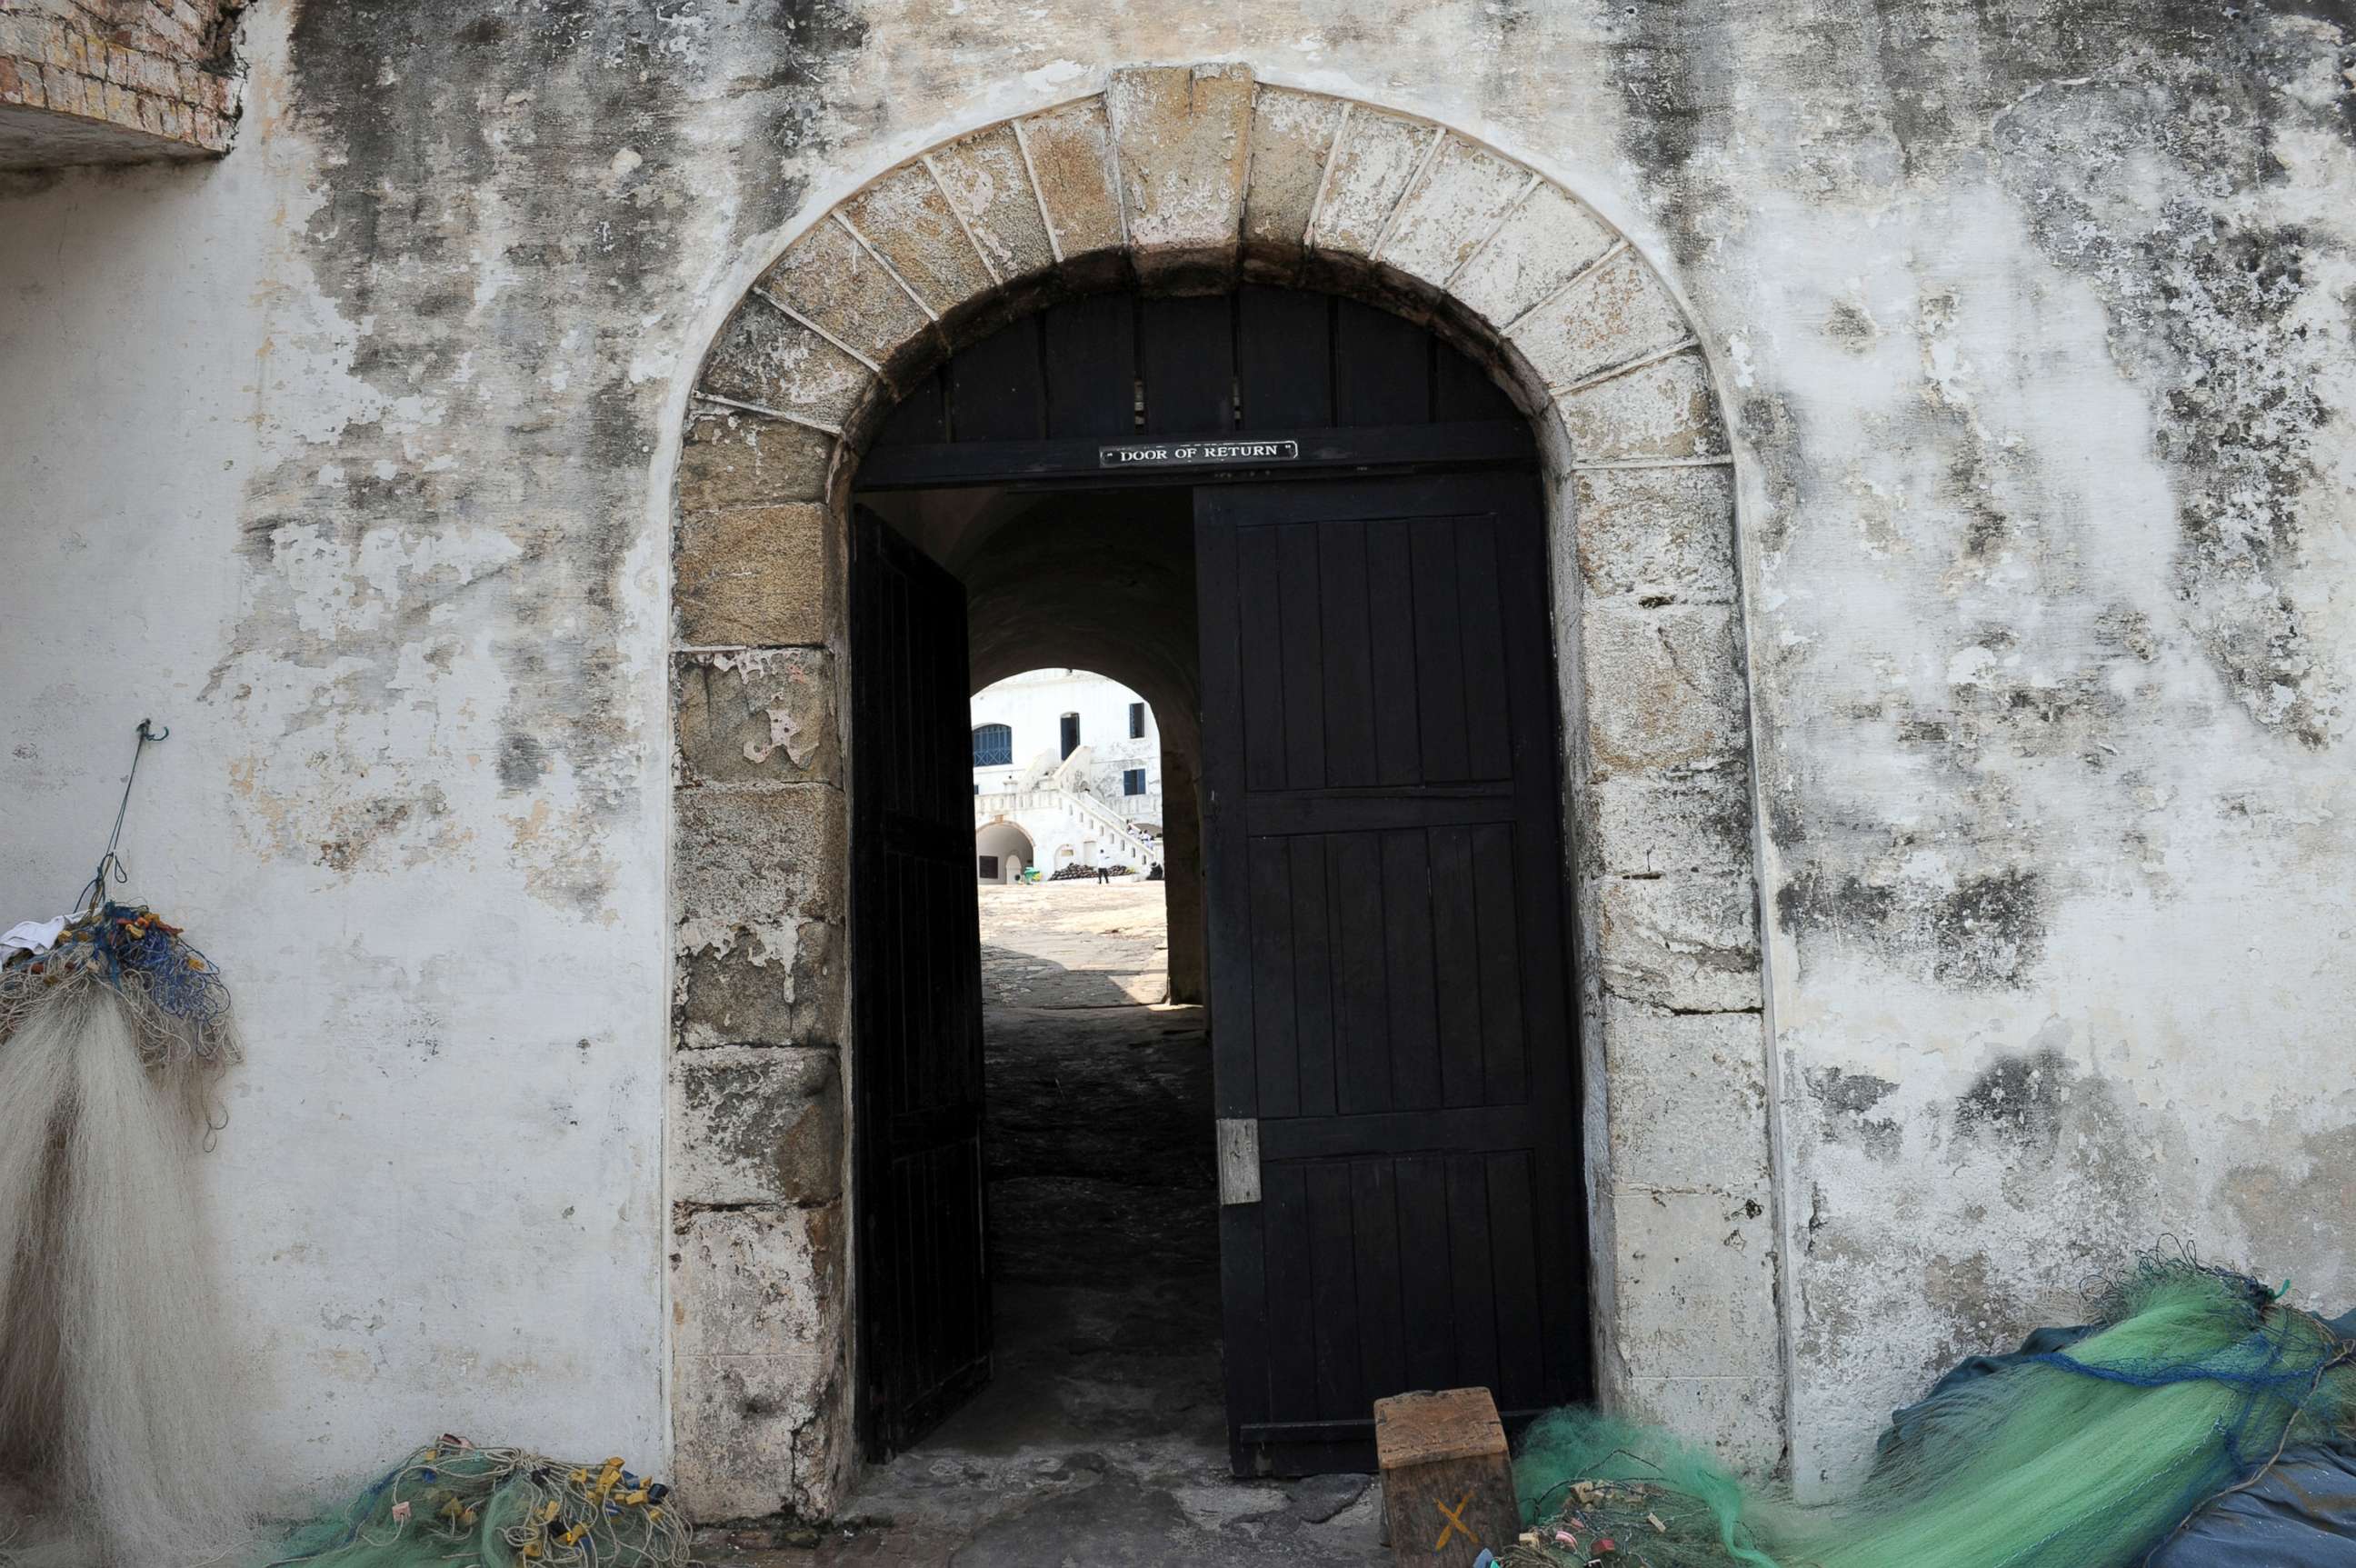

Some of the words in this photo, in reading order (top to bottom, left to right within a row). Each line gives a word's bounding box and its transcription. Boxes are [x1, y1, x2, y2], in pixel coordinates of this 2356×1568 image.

[1120, 449, 1168, 462] DOOR
[1174, 447, 1197, 459] OF
[1203, 444, 1278, 458] RETURN
